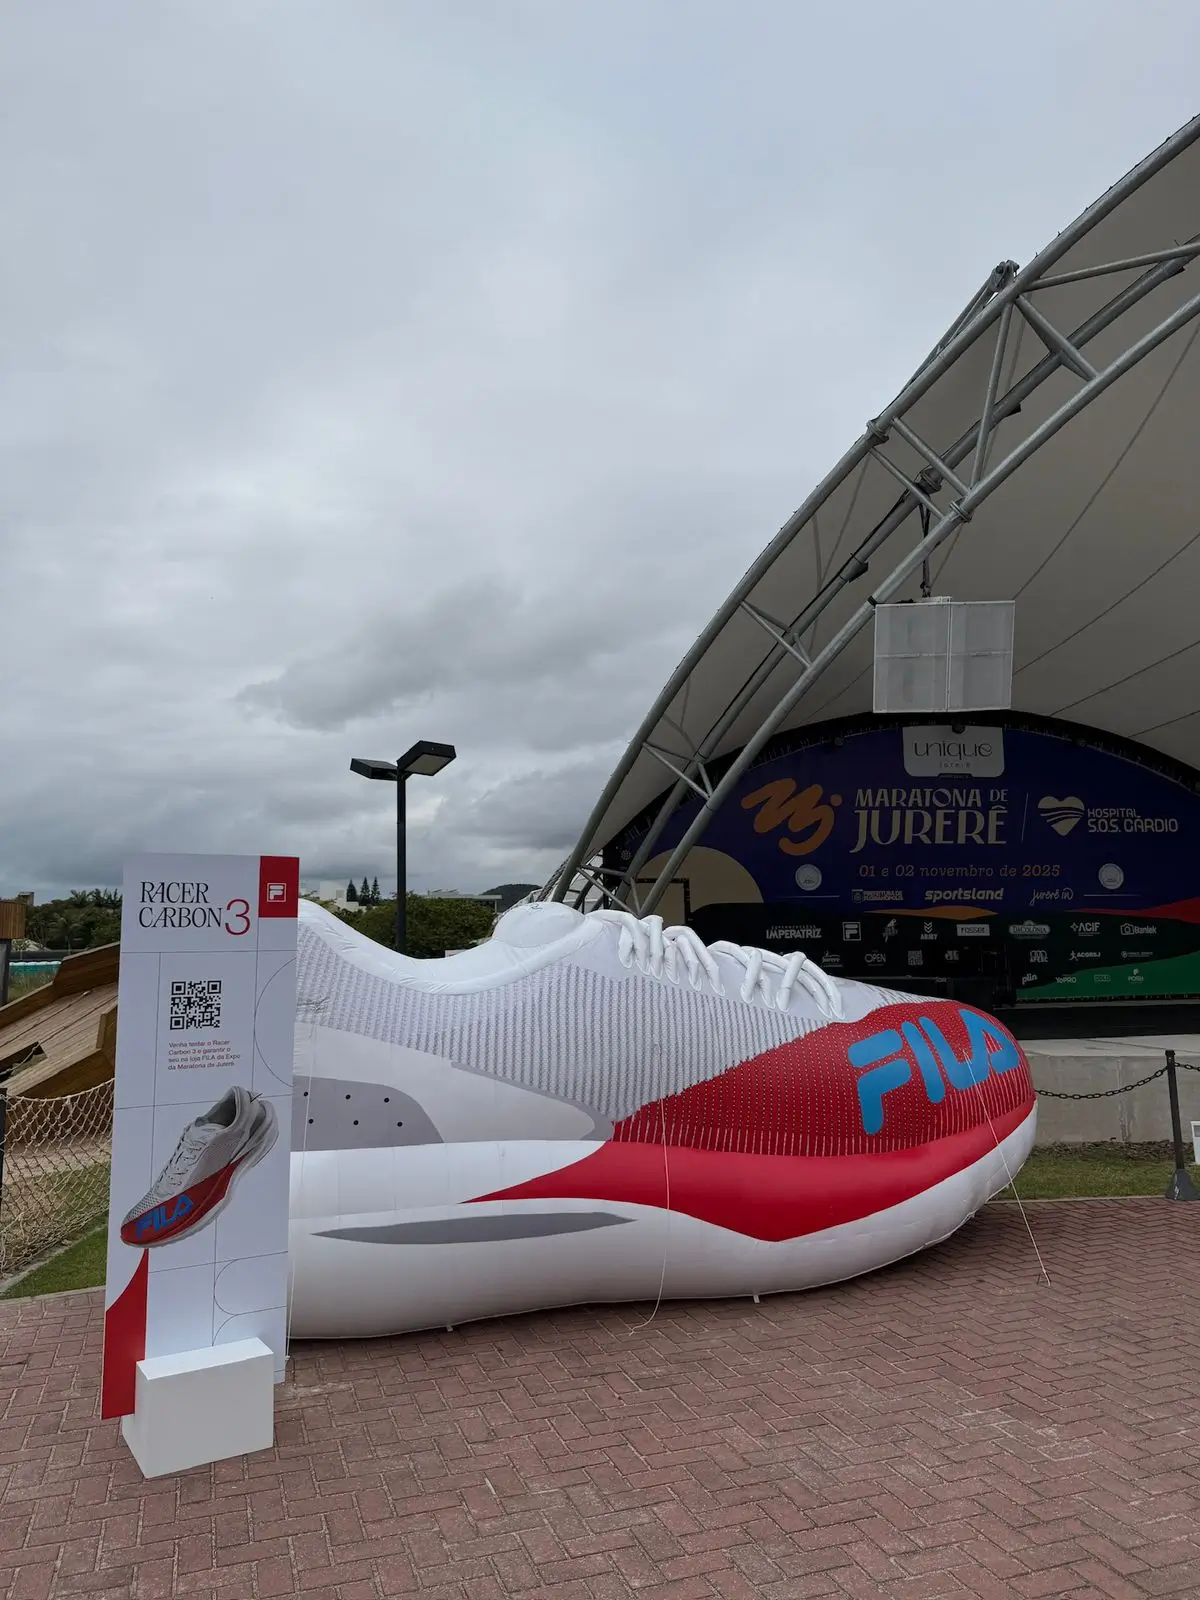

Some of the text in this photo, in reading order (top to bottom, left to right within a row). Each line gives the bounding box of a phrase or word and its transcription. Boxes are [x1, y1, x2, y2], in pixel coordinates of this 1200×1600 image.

[914, 741, 993, 760] unique
[855, 788, 1009, 807] MARATONA DE
[1087, 808, 1142, 818] HOSPITAL
[849, 805, 1009, 853] JURERÊ
[1087, 818, 1122, 833] S.O.S.
[859, 864, 1060, 877] 01 e 02 novembro de 2025
[140, 881, 210, 904] RACER
[925, 887, 1004, 903] sportsland
[139, 898, 250, 936] CARBON 3
[766, 928, 822, 939] IMPERATRIZ
[1078, 922, 1101, 932] ACIF
[177, 1062, 206, 1070] Maratona
[848, 1009, 1021, 1135] FILA
[135, 1194, 193, 1240] FILA
